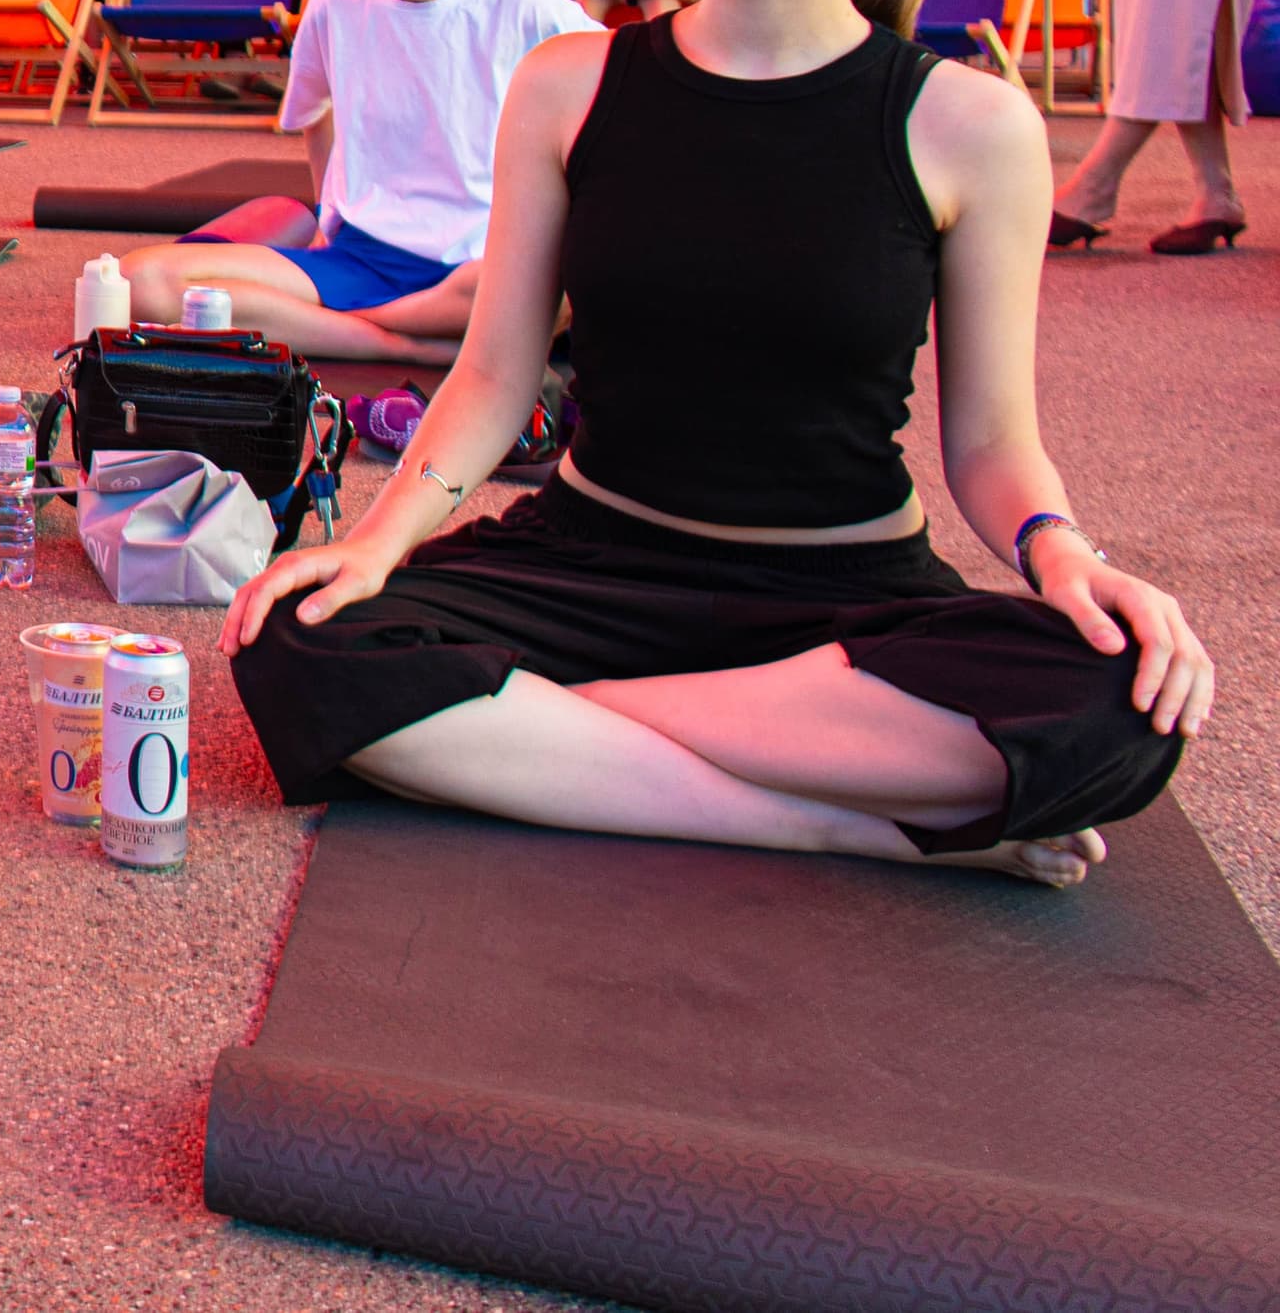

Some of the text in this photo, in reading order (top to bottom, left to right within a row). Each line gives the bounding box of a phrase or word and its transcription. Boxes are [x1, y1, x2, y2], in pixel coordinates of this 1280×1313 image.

[51, 687, 103, 705] БАЛТИ
[51, 749, 76, 792] 0
[128, 732, 178, 815] 0
